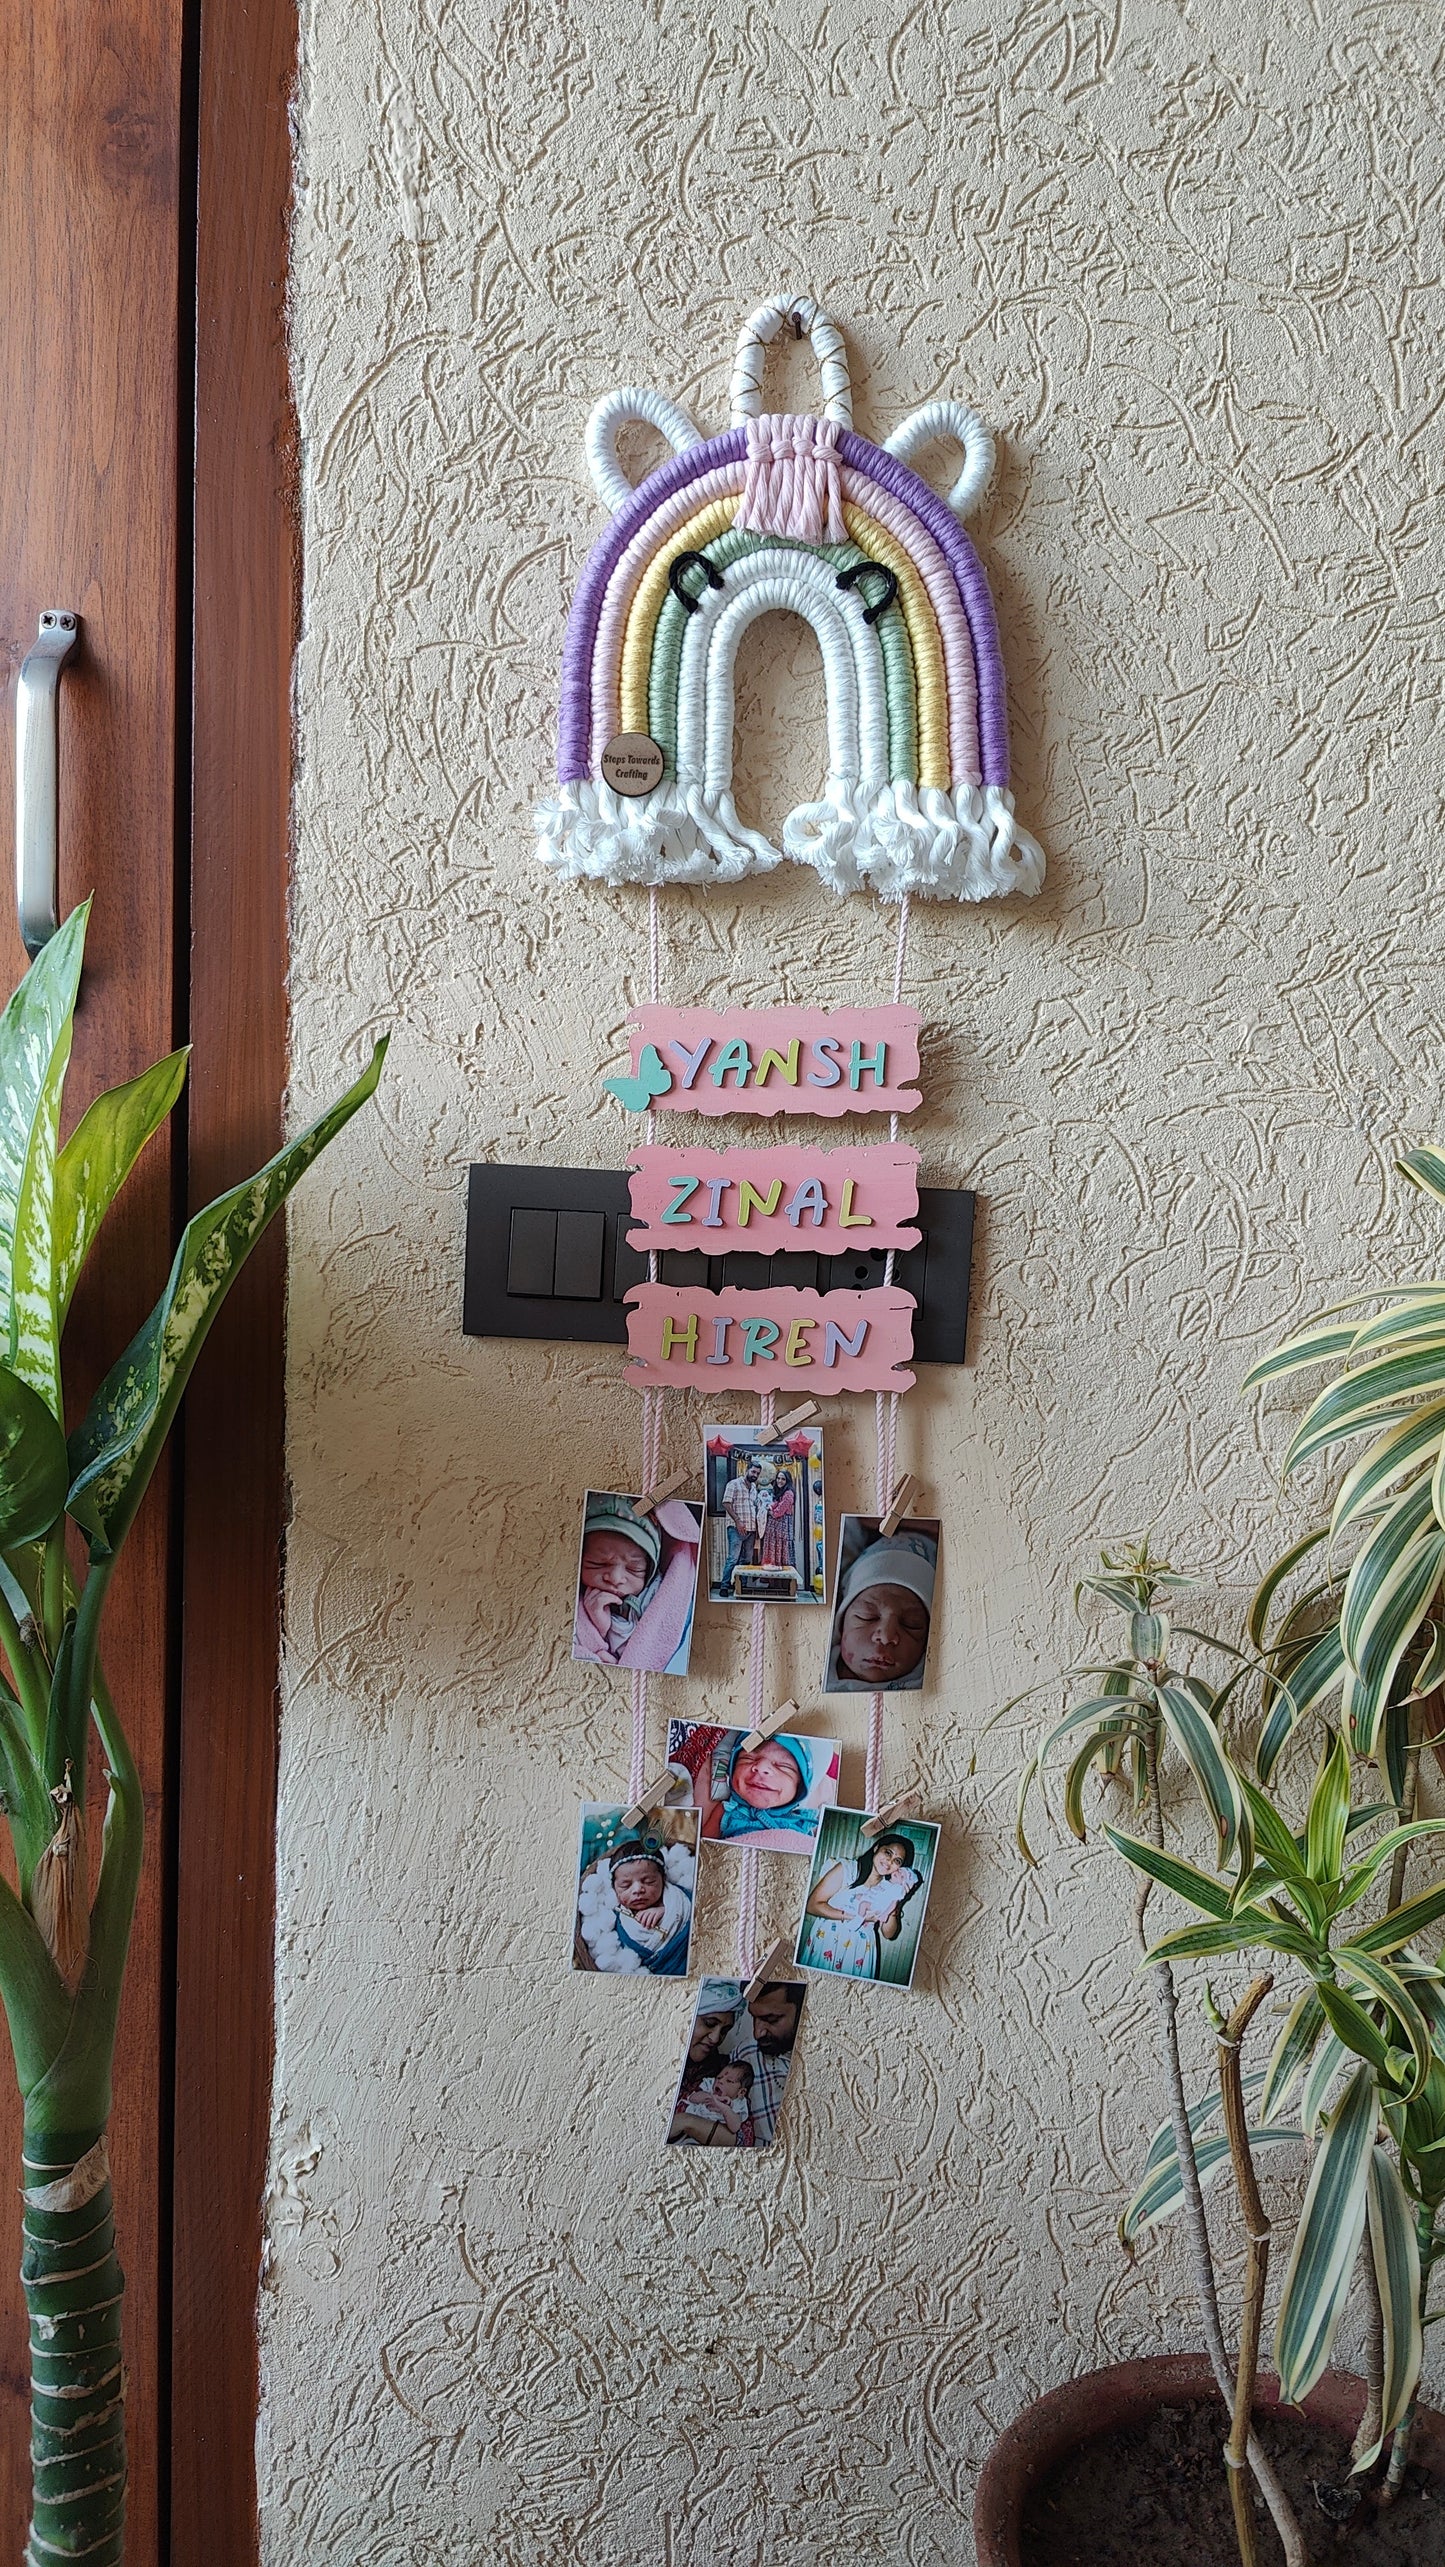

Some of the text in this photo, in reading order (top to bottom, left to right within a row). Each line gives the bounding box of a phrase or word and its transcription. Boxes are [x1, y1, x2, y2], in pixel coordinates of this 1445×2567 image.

[603, 754, 661, 765] Steps Towards
[615, 769, 648, 781] Crafting
[669, 1038, 886, 1089] YANSH
[661, 1178, 873, 1228] ZINAL
[662, 1314, 870, 1367] HIREN
